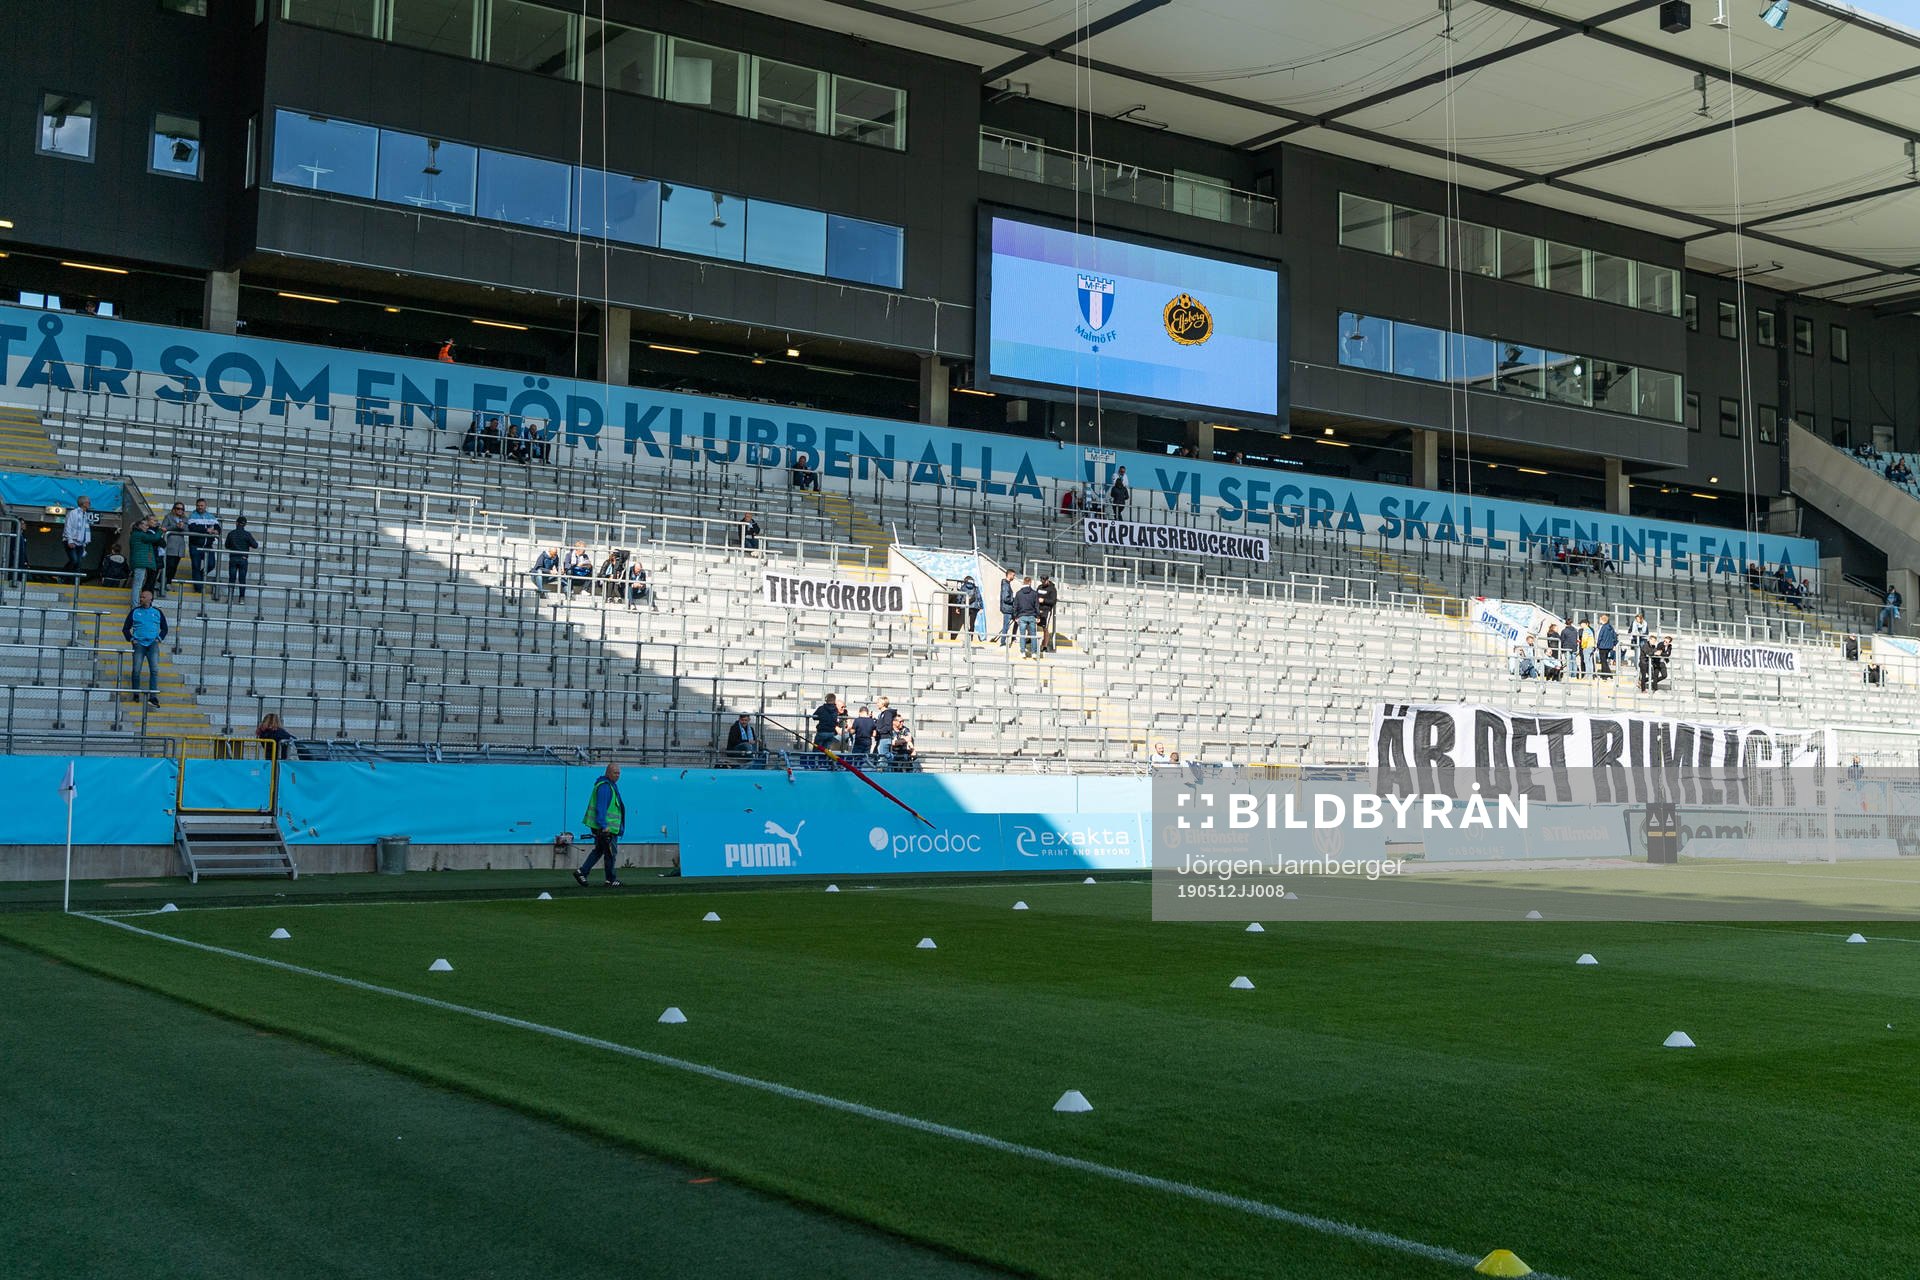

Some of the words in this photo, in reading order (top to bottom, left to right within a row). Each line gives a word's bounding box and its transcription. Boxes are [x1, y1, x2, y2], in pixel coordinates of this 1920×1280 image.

[1074, 325, 1106, 344] Malmö
[1107, 329, 1117, 341] FF
[155, 345, 330, 421] SOM
[356, 368, 448, 430] EN
[473, 375, 604, 450] FÖR
[624, 402, 895, 480] KLUBBEN
[913, 440, 1043, 500] ALLA
[1155, 468, 1201, 516] VI
[1216, 476, 1365, 532] SEGRA
[1378, 496, 1506, 550] SKALL
[1519, 513, 1599, 553] MEN
[1611, 525, 1689, 570] INTE
[1700, 536, 1796, 582] FALLA
[1087, 520, 1265, 561] STÅPLATSREDUCERING
[766, 575, 903, 612] TIFOFÖRBUD
[1698, 645, 1795, 671] INTIMVISITERING
[1376, 703, 1458, 800] ÄR
[1475, 709, 1575, 803] DET
[892, 829, 982, 859] prodoc
[1041, 826, 1130, 846] exakta
[725, 843, 792, 868] PUMA
[1041, 848, 1069, 857] PRINT
[1073, 848, 1090, 857] AND
[1094, 847, 1131, 856] BEYOND
